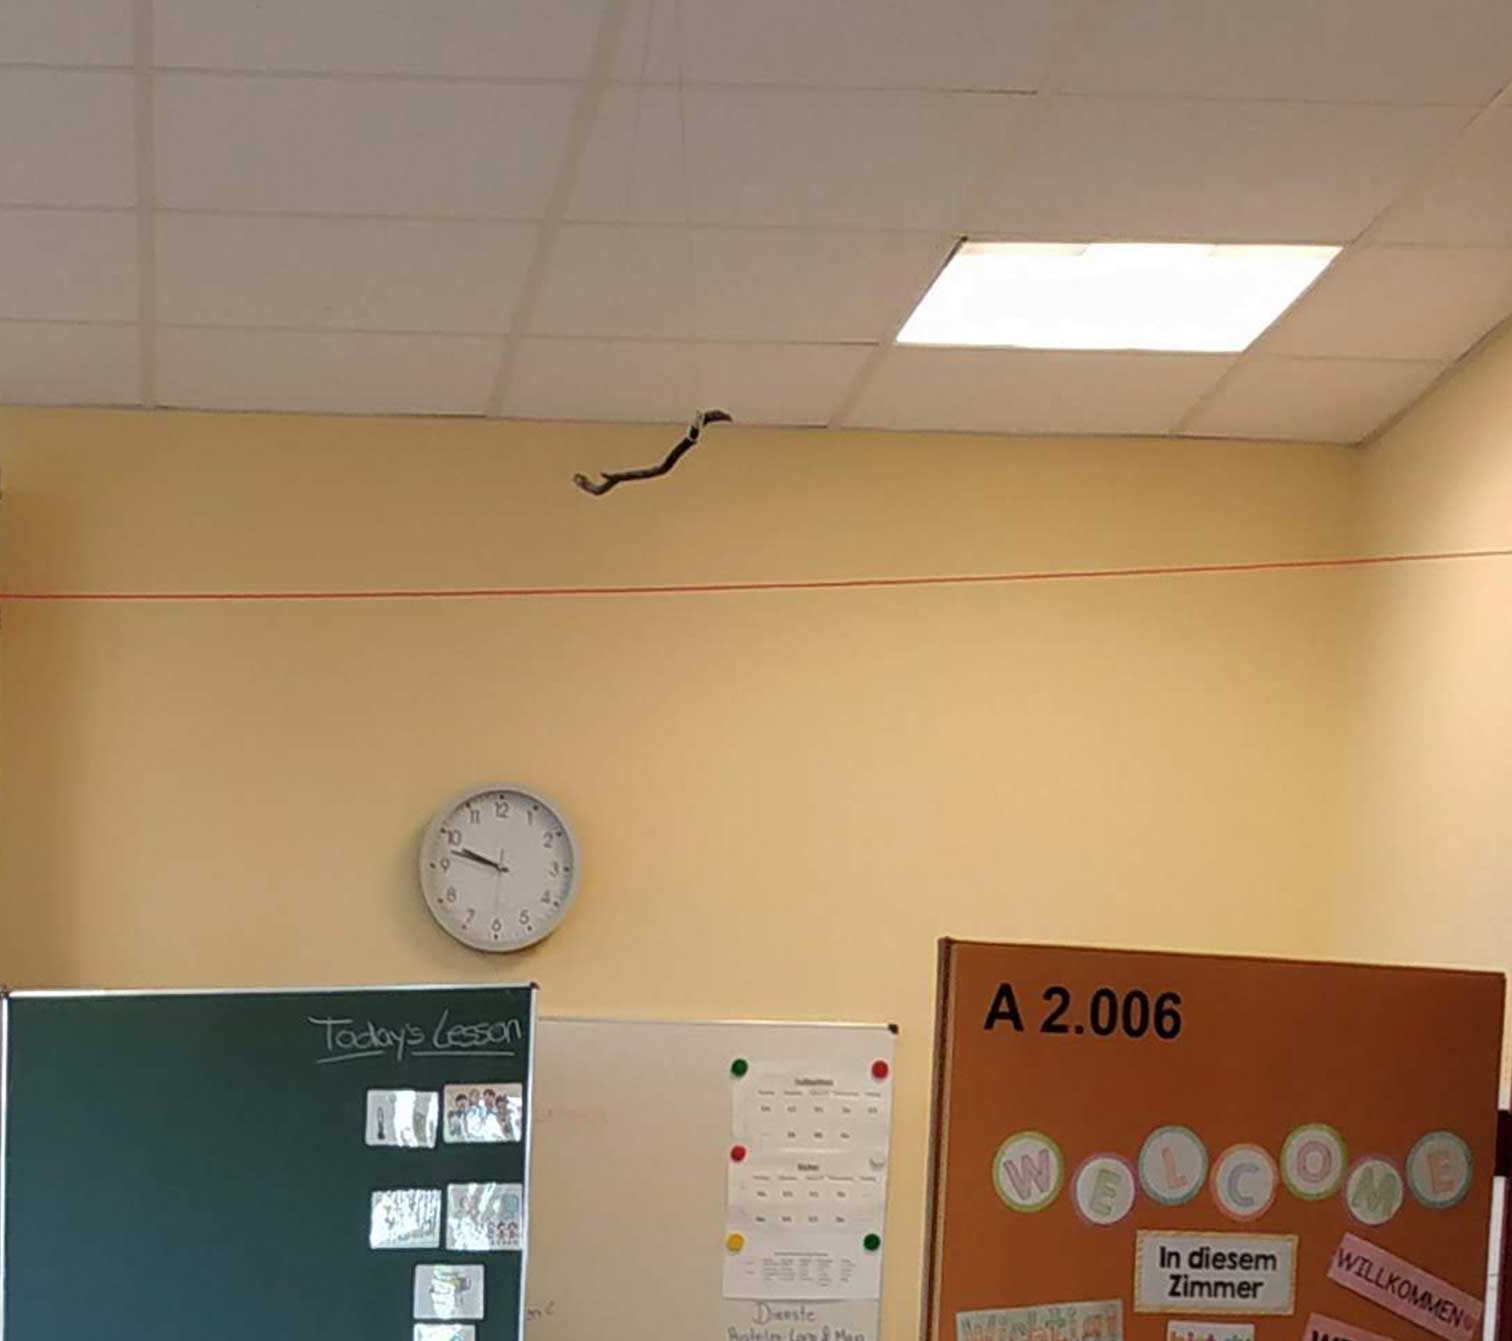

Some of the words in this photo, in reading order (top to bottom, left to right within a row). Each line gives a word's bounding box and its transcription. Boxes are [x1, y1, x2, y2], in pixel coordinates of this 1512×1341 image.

[469, 811, 480, 824] 11
[495, 803, 509, 817] 12
[526, 811, 533, 825] 1
[447, 831, 461, 845] 10
[543, 833, 554, 848] 2
[440, 860, 449, 873] 9
[550, 861, 559, 876] 3
[447, 888, 457, 903] 8
[541, 891, 550, 904] 4
[466, 909, 476, 924] 7
[519, 909, 530, 924] 5
[492, 918, 501, 931] 6
[983, 982, 1024, 1033] A
[1040, 988, 1183, 1041] 2.006
[308, 1016, 425, 1061] Today's
[433, 1009, 522, 1049] Lesson
[1001, 1138, 1458, 1219] WELCOME
[1159, 1246, 1182, 1269] In
[1188, 1247, 1278, 1273] diesem
[1168, 1275, 1264, 1301] Zimmer
[1335, 1247, 1464, 1330] WILLKOMMEN
